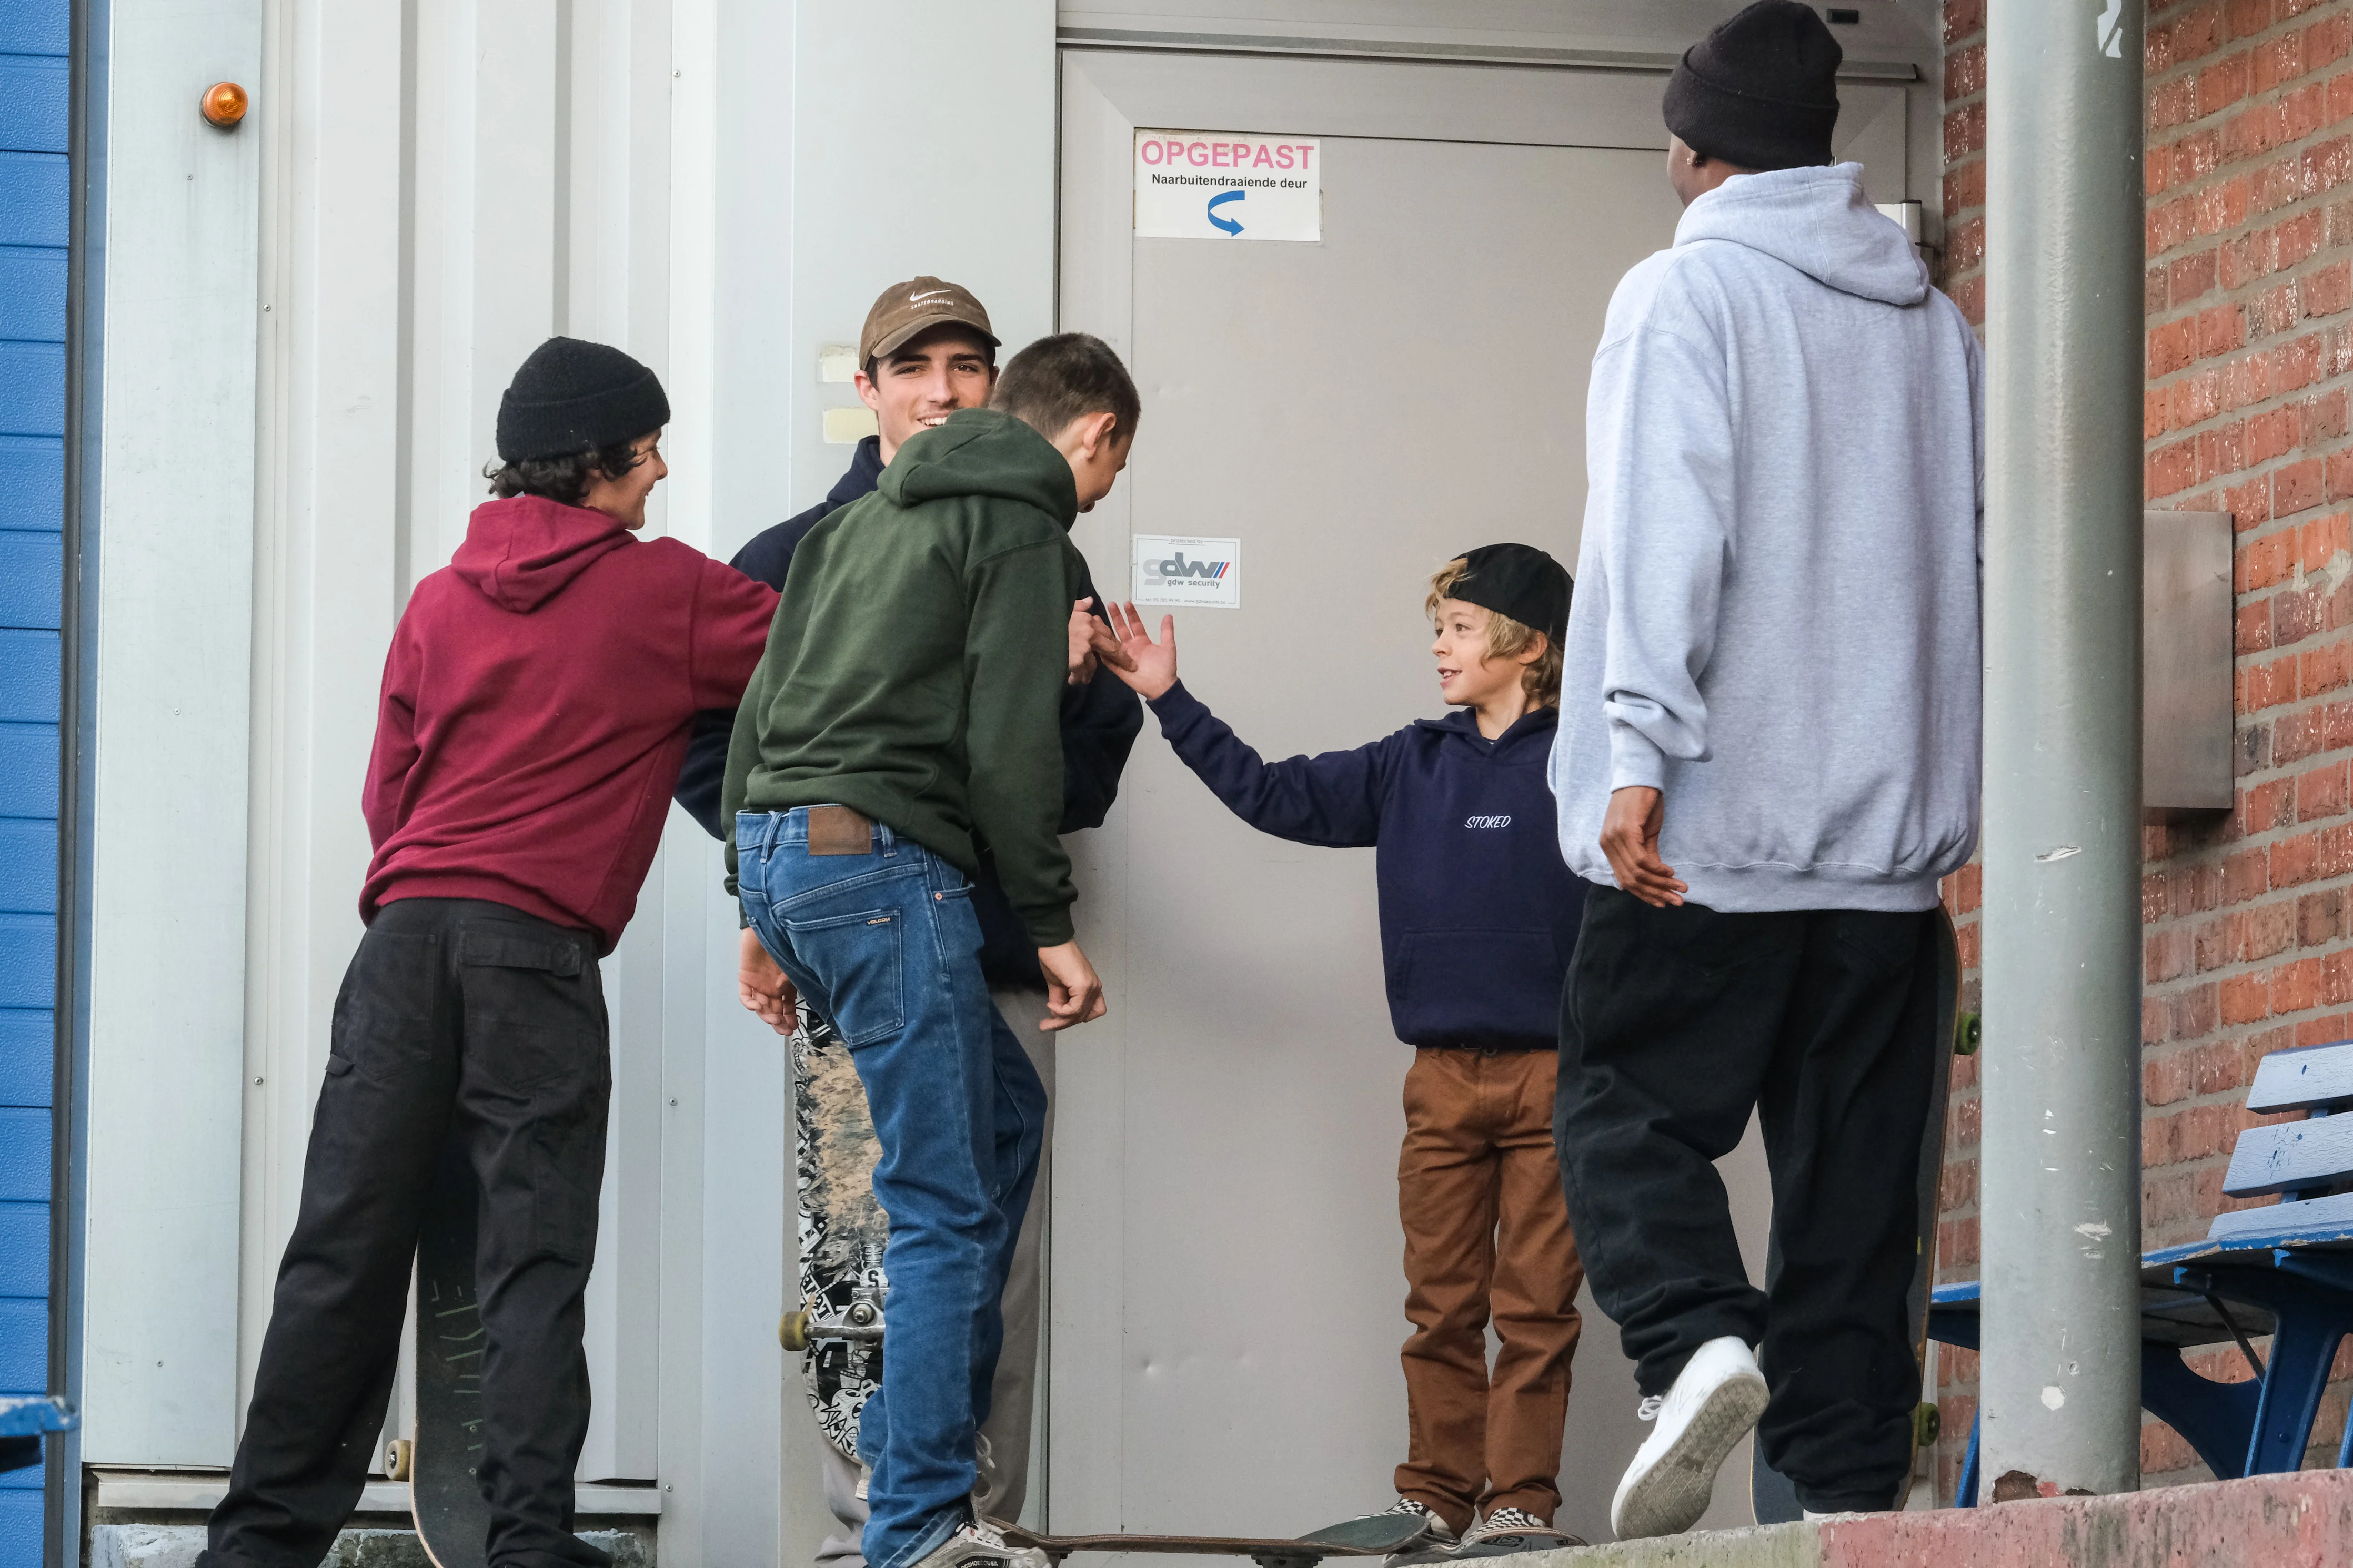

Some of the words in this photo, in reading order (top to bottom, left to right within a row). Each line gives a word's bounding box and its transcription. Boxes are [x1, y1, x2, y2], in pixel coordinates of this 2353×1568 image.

[1141, 140, 1314, 169] OPGEPAST
[1152, 174, 1276, 188] Naarbuitendraaiende
[1280, 178, 1308, 188] deur
[911, 299, 954, 310] SKATEBOARDING
[1188, 580, 1220, 589] security
[1464, 815, 1511, 829] STOKED
[867, 917, 891, 925] VOLCOM
